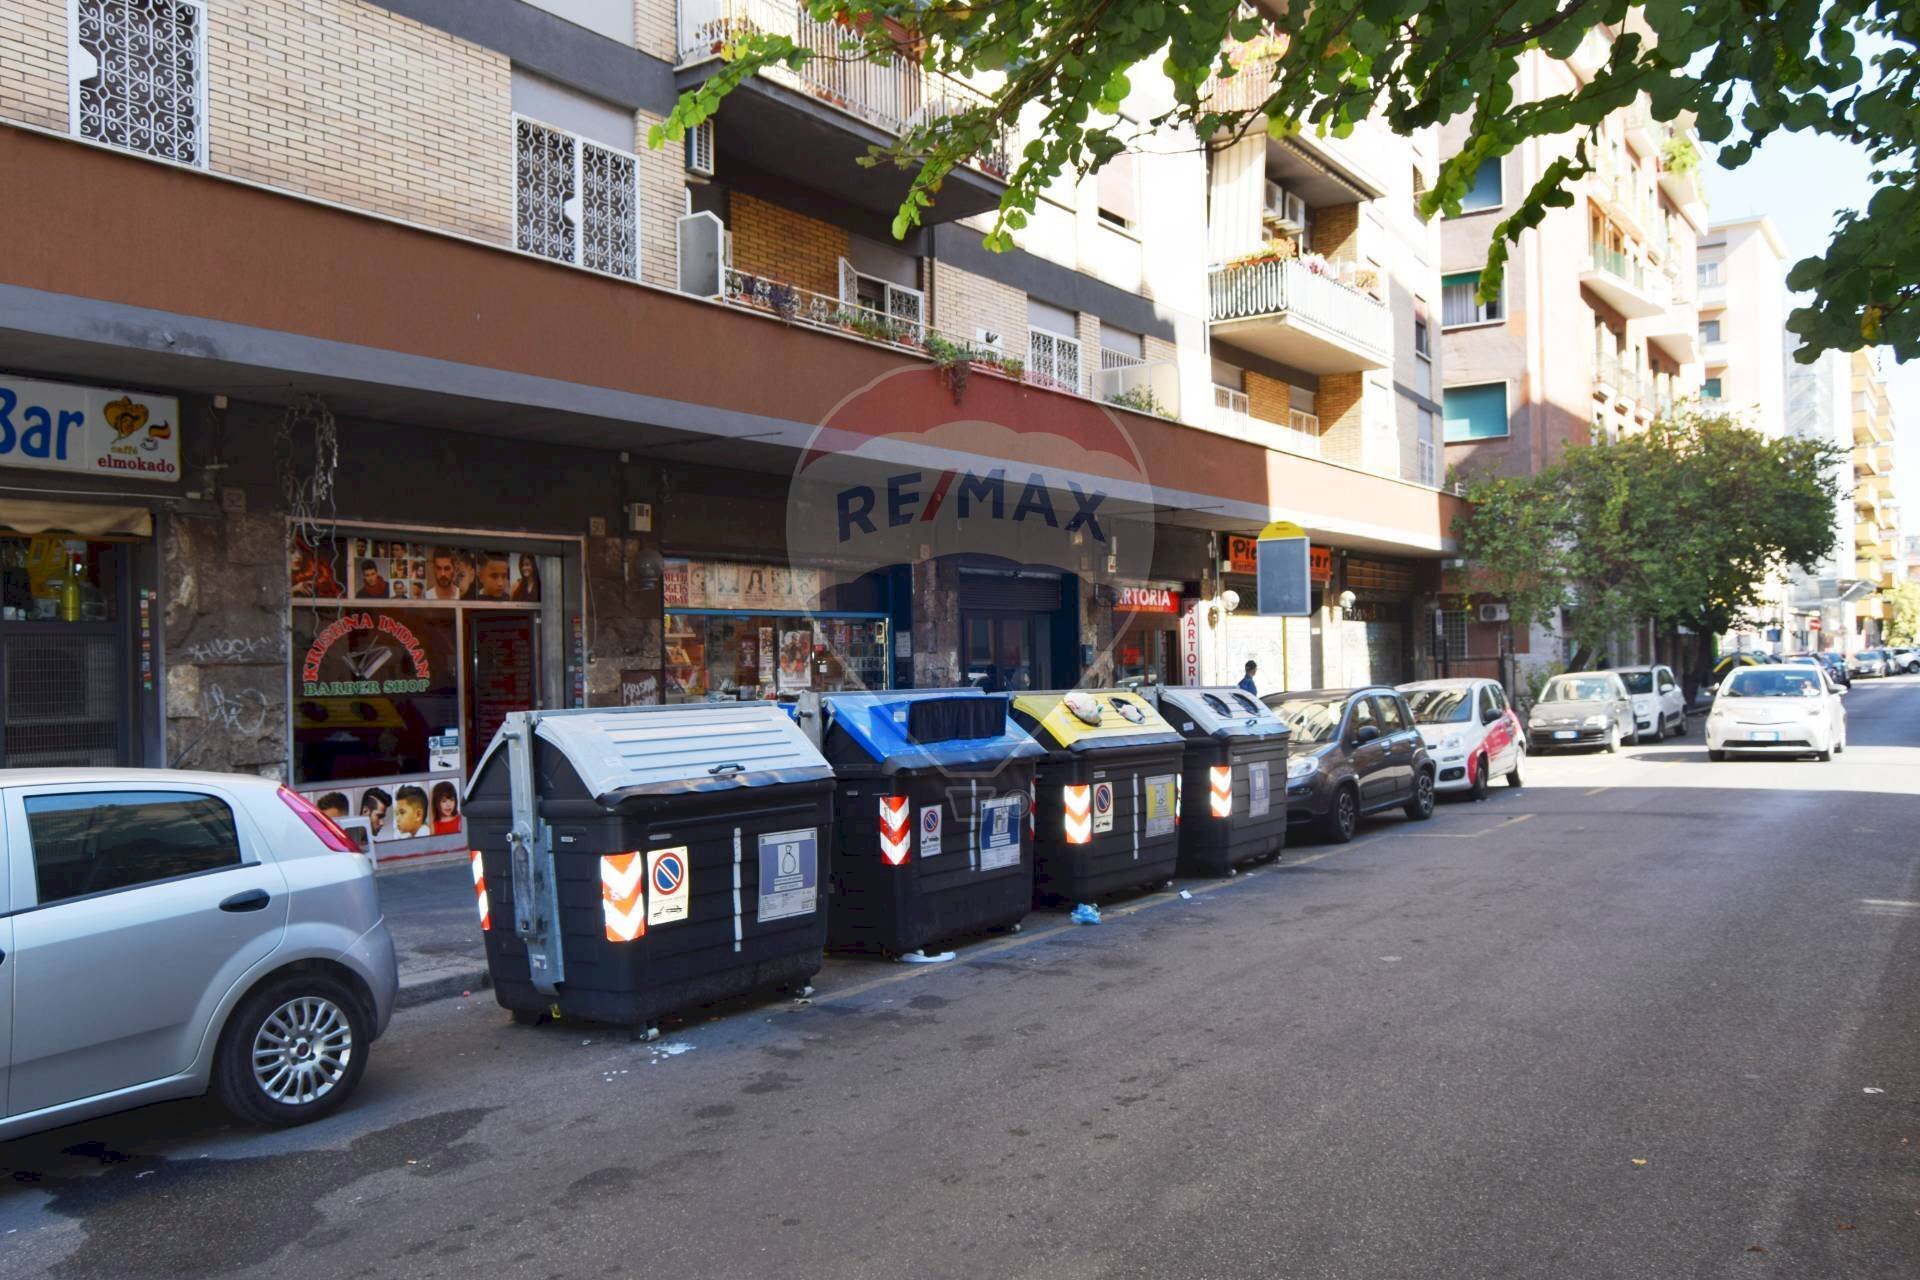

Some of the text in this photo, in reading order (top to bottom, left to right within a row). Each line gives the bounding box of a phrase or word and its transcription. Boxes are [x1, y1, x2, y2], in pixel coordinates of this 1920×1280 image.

[0, 387, 85, 461] Bar
[97, 454, 176, 473] elmokado
[1119, 587, 1171, 606] RTORIA
[378, 614, 431, 680] INDIAN
[303, 679, 431, 697] BARBER SHOP
